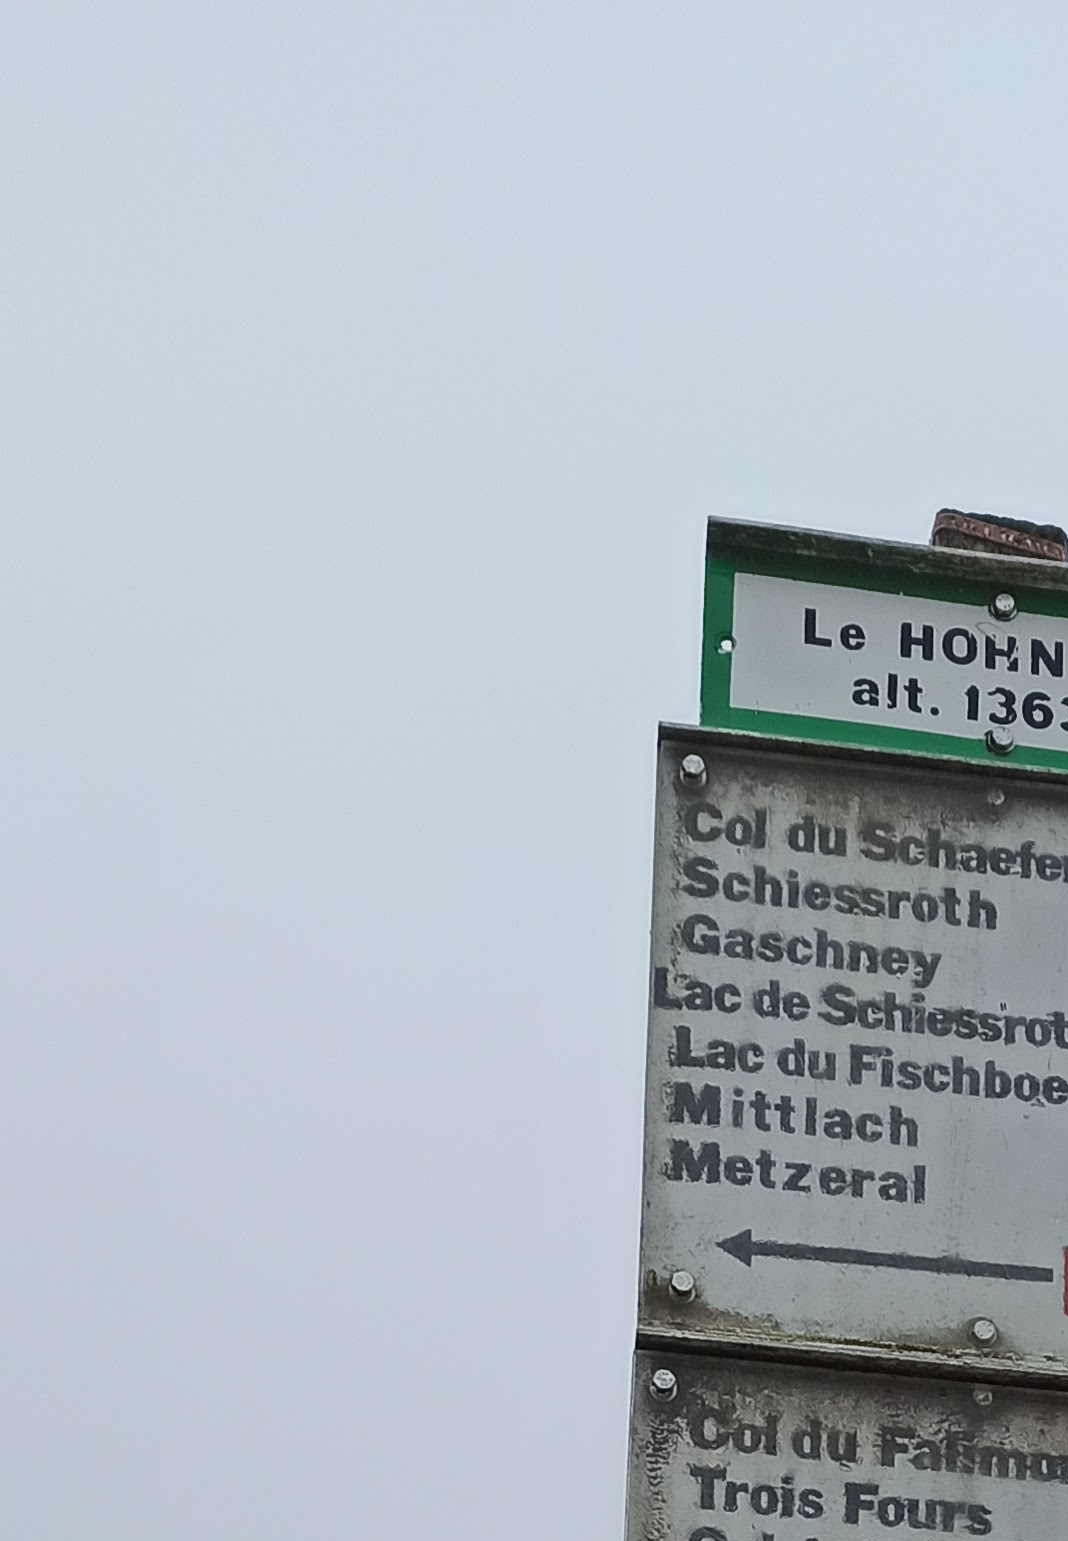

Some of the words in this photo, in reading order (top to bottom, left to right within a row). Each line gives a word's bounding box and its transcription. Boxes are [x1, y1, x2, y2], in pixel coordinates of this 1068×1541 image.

[803, 607, 867, 652] Le
[851, 672, 941, 717] alt.
[684, 803, 767, 849] Col
[787, 815, 847, 857] du
[681, 857, 998, 930] Schiessroth
[681, 914, 942, 988] Gaschney
[654, 967, 741, 1013] Lac
[754, 979, 811, 1021] de
[671, 1026, 764, 1073] Lac
[777, 1038, 836, 1081] du
[668, 1082, 919, 1147] Mittlach
[666, 1139, 926, 1204] Metzeral
[688, 1406, 778, 1456] Col
[791, 1418, 858, 1463] du
[689, 1464, 824, 1518] Trois
[843, 1482, 993, 1535] Fours
